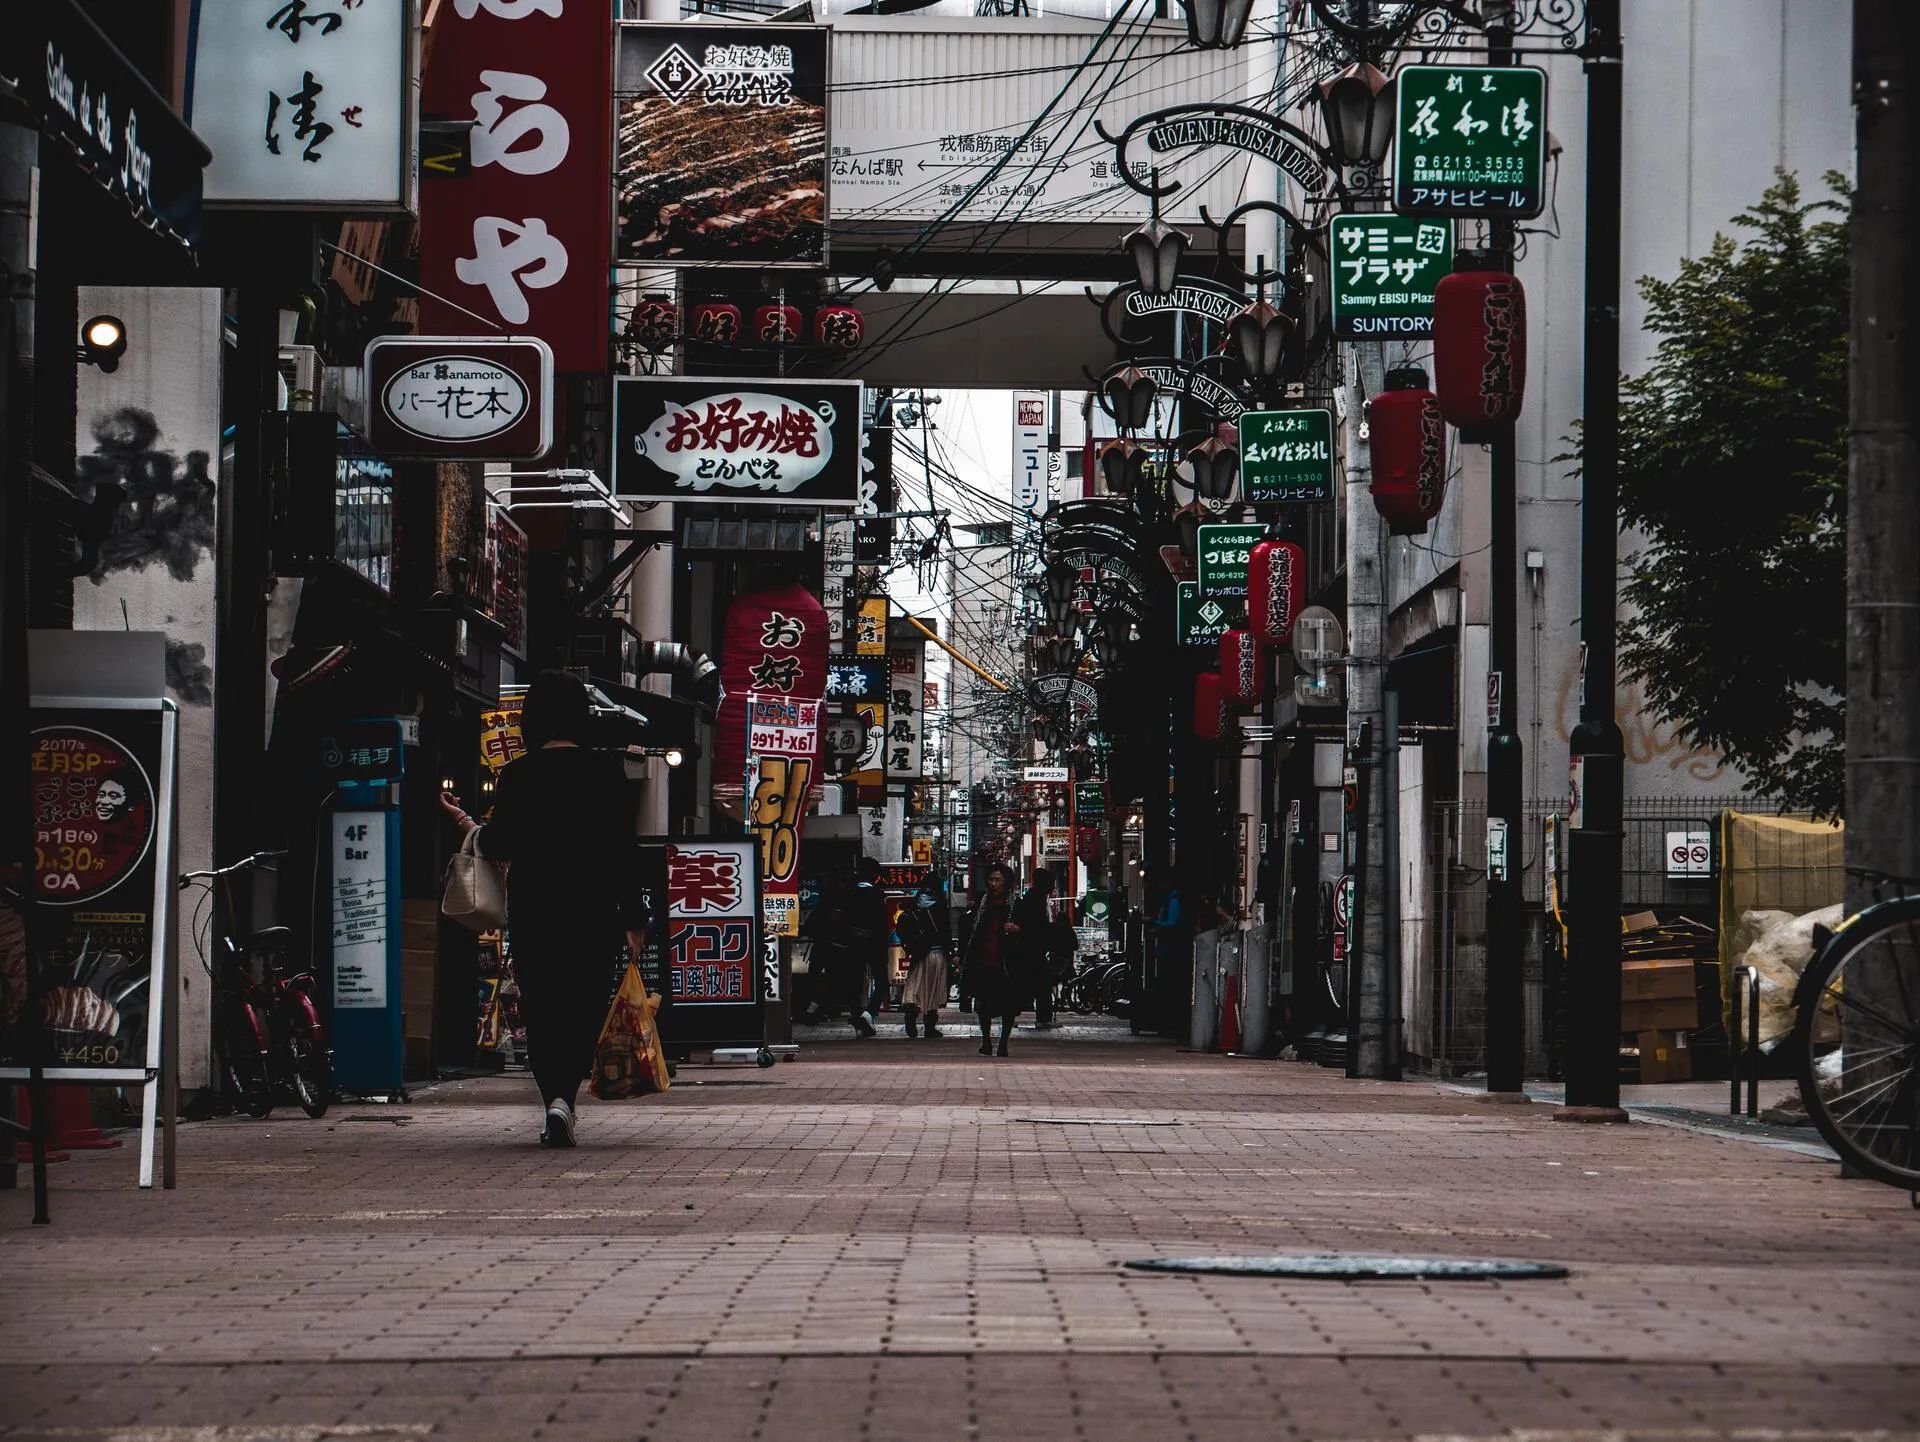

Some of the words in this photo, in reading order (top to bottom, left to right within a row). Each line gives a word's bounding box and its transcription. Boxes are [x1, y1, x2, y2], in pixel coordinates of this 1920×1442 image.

[706, 45, 792, 68] お好み焼
[704, 73, 793, 105] とんべえ
[832, 146, 851, 156] 南海
[832, 158, 904, 177] なんば駅
[1432, 156, 1524, 168] 6213-3553
[832, 178, 857, 186] Nankai
[859, 178, 885, 186] Namba
[887, 178, 904, 186] Sta.
[1411, 187, 1527, 208] アサヒビール
[1340, 257, 1429, 286] プラザ
[1341, 293, 1378, 307] Sammy
[1379, 292, 1409, 305] EBISU
[1353, 316, 1435, 333] SUNTORY
[410, 369, 431, 380] Bar
[398, 386, 512, 419] バー花本
[1019, 401, 1033, 413] NEW
[1019, 412, 1043, 425] JAPAN
[666, 397, 821, 458] お好み焼
[695, 457, 783, 480] とんべえ
[1263, 473, 1323, 483] 6211-5300
[1252, 487, 1325, 501] サントリービール
[749, 610, 805, 693] お好
[40, 738, 88, 751] 2017年
[344, 824, 368, 841] 4F
[957, 803, 969, 851] HTEL
[344, 847, 369, 860] Bar
[43, 872, 81, 890] OA
[343, 906, 378, 919] Traditional
[345, 921, 358, 931] and
[359, 919, 377, 929] more
[59, 1045, 118, 1065] ¥450
